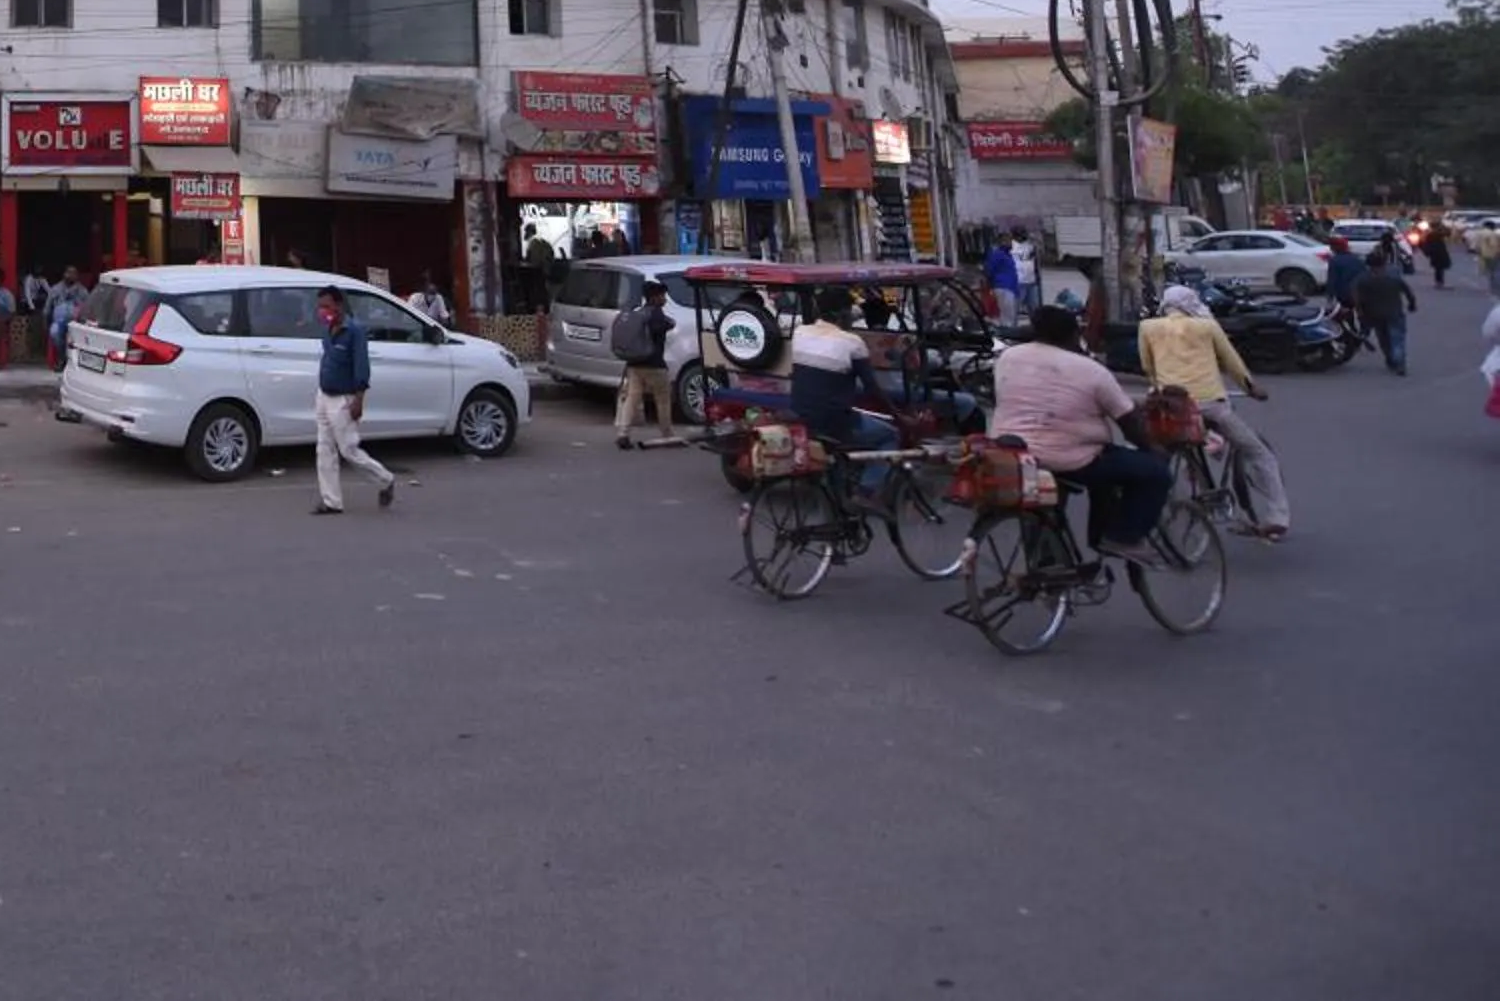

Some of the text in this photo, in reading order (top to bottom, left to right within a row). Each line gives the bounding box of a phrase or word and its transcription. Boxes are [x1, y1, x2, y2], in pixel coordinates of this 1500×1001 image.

[143, 79, 221, 102] मछली घर
[16, 129, 124, 150] VOLUE
